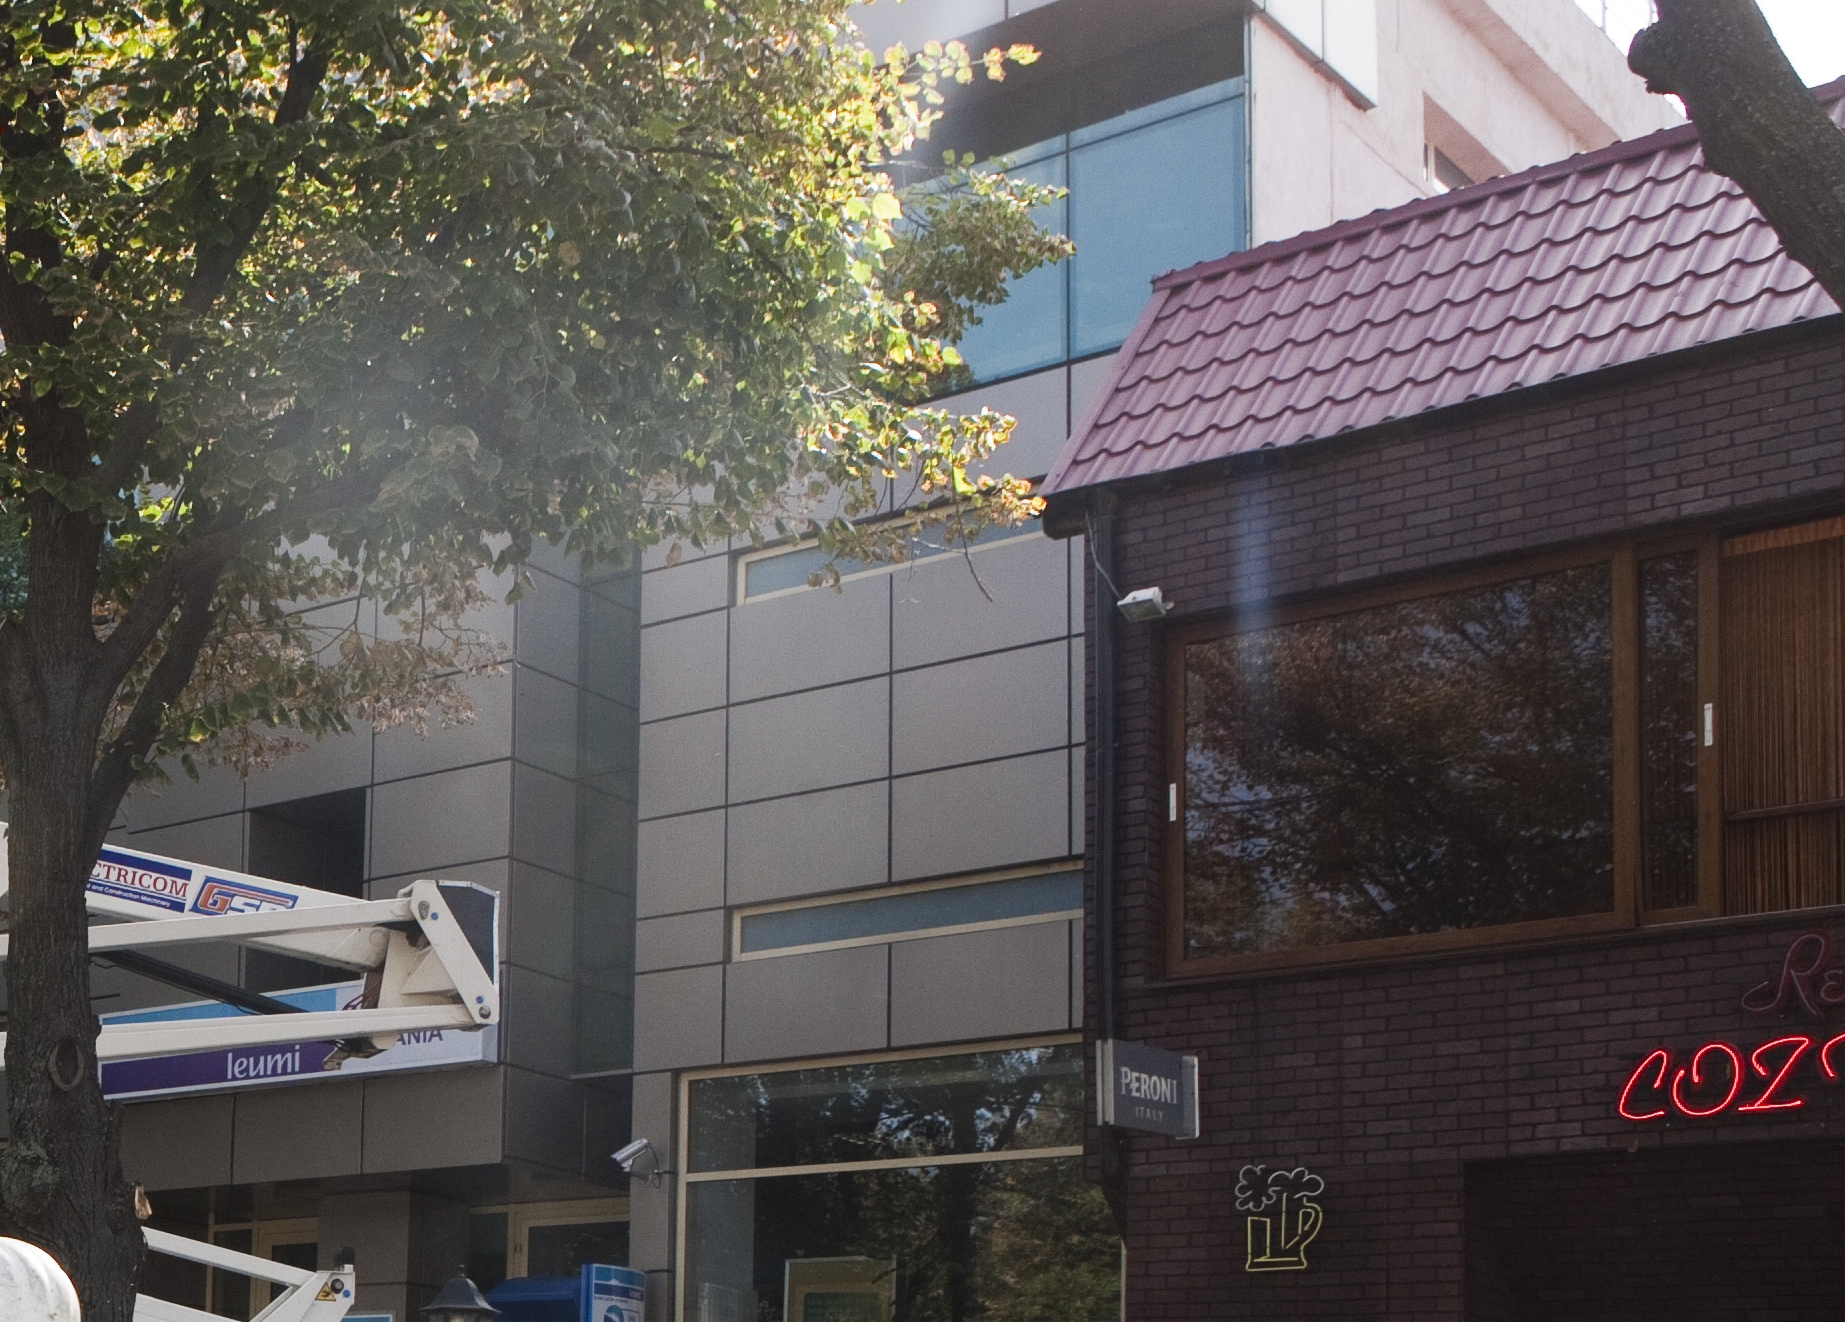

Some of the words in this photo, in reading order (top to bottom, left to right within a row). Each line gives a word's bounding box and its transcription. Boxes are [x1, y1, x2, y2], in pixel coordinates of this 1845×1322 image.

[226, 1045, 301, 1080] leumi
[1120, 1066, 1178, 1105] PERONI
[1135, 1106, 1165, 1121] ITALY
